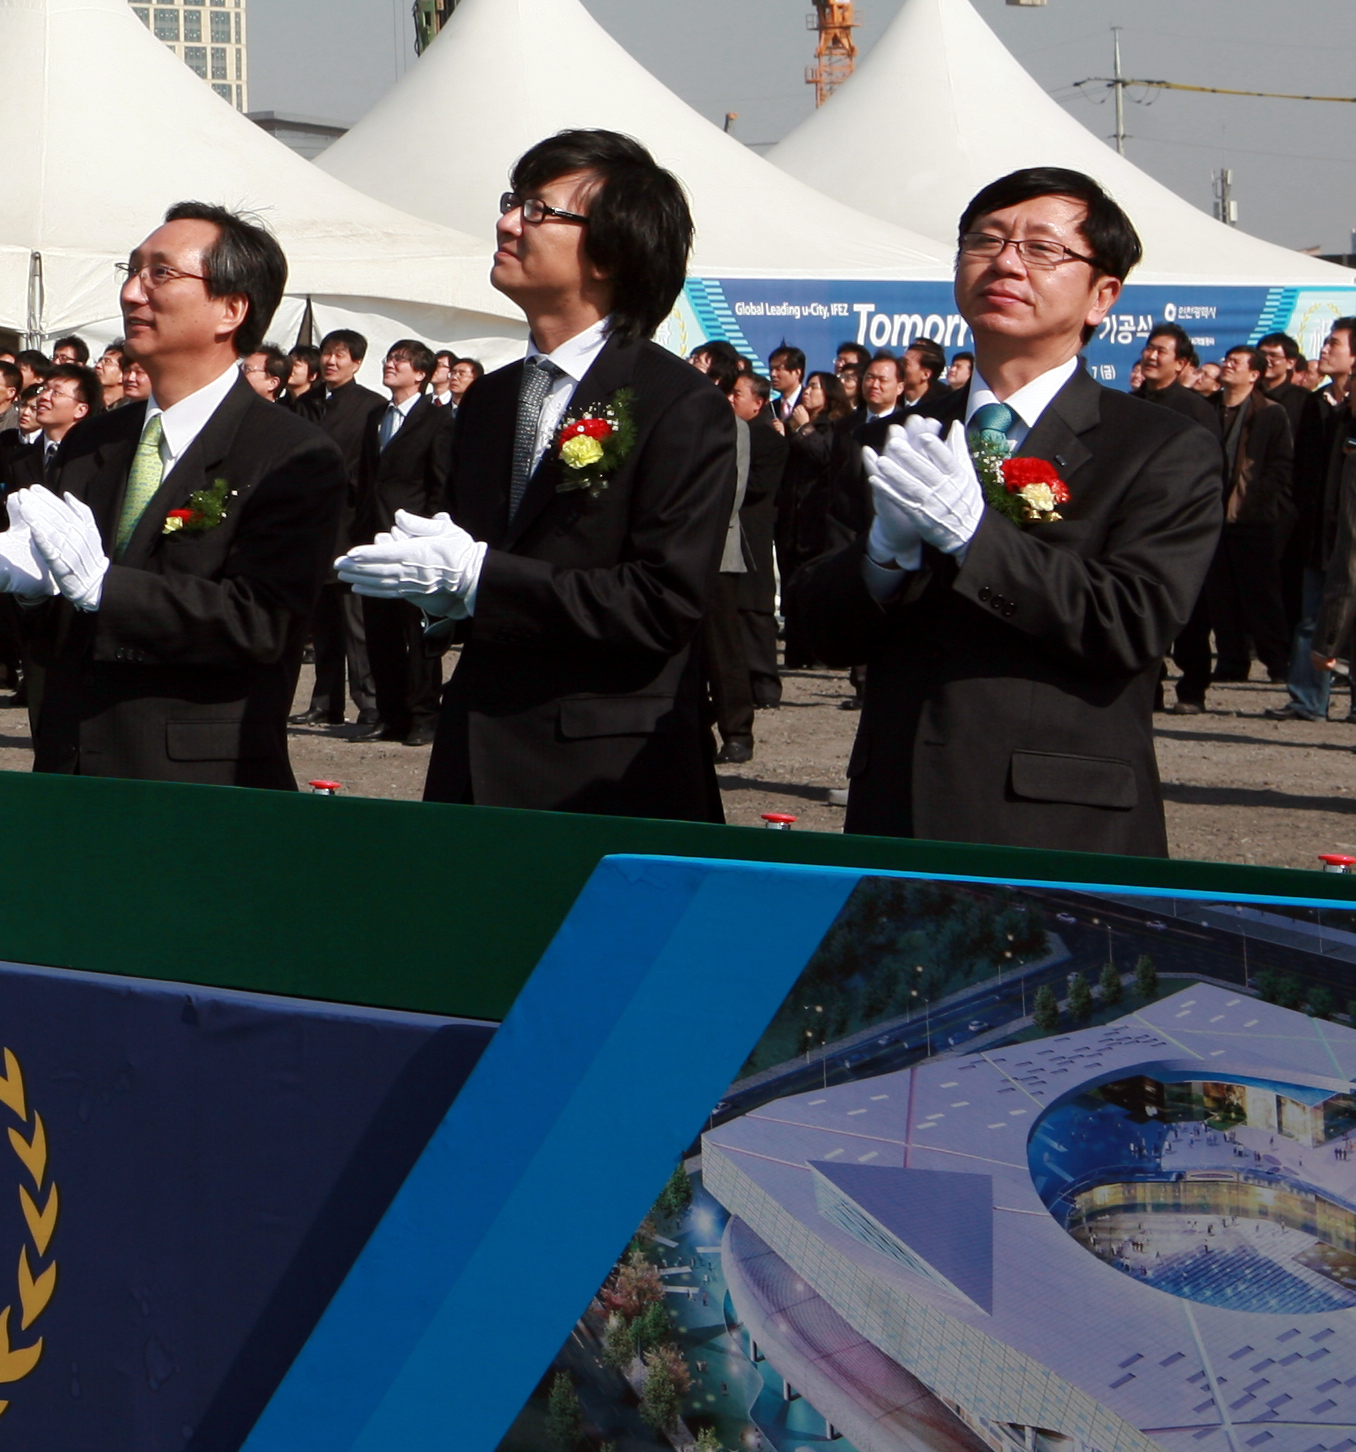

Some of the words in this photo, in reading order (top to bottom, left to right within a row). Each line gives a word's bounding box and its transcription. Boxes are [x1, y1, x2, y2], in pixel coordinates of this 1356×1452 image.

[735, 302, 764, 316] Global
[765, 302, 800, 319] Leading
[801, 302, 830, 319] u-City,
[830, 303, 849, 316] IFEZ
[853, 303, 975, 347] Tomorr
[1099, 314, 1154, 344] 기공식
[1100, 364, 1116, 380] (금)
